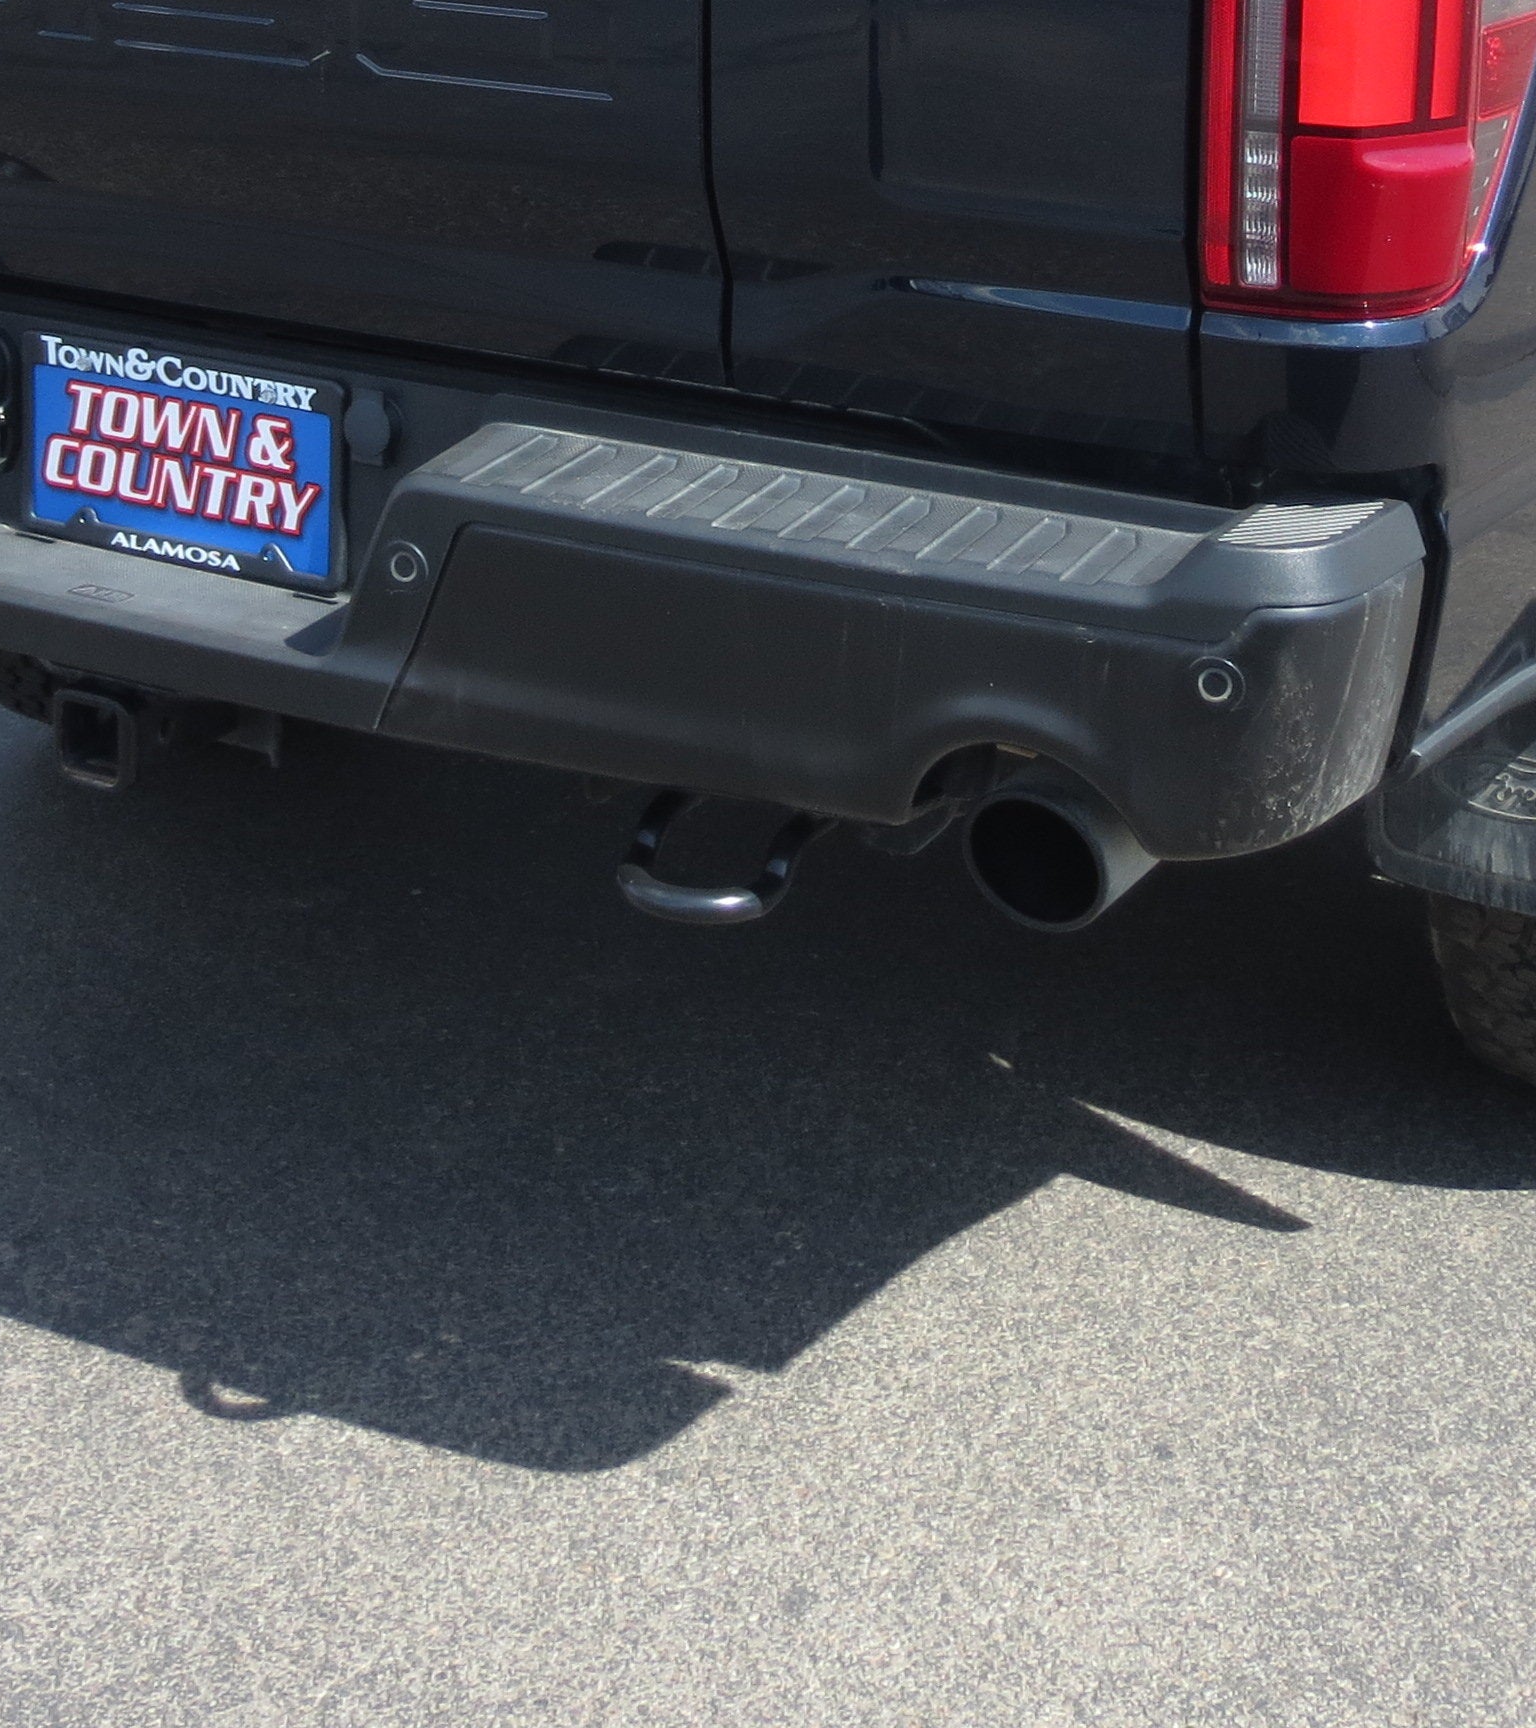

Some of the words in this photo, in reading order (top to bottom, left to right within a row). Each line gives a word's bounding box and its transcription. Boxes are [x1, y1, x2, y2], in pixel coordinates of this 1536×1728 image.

[67, 382, 240, 461] TOWN
[248, 413, 295, 474] &
[45, 436, 320, 535] COUNTRY
[111, 532, 241, 571] ALAMOSA
